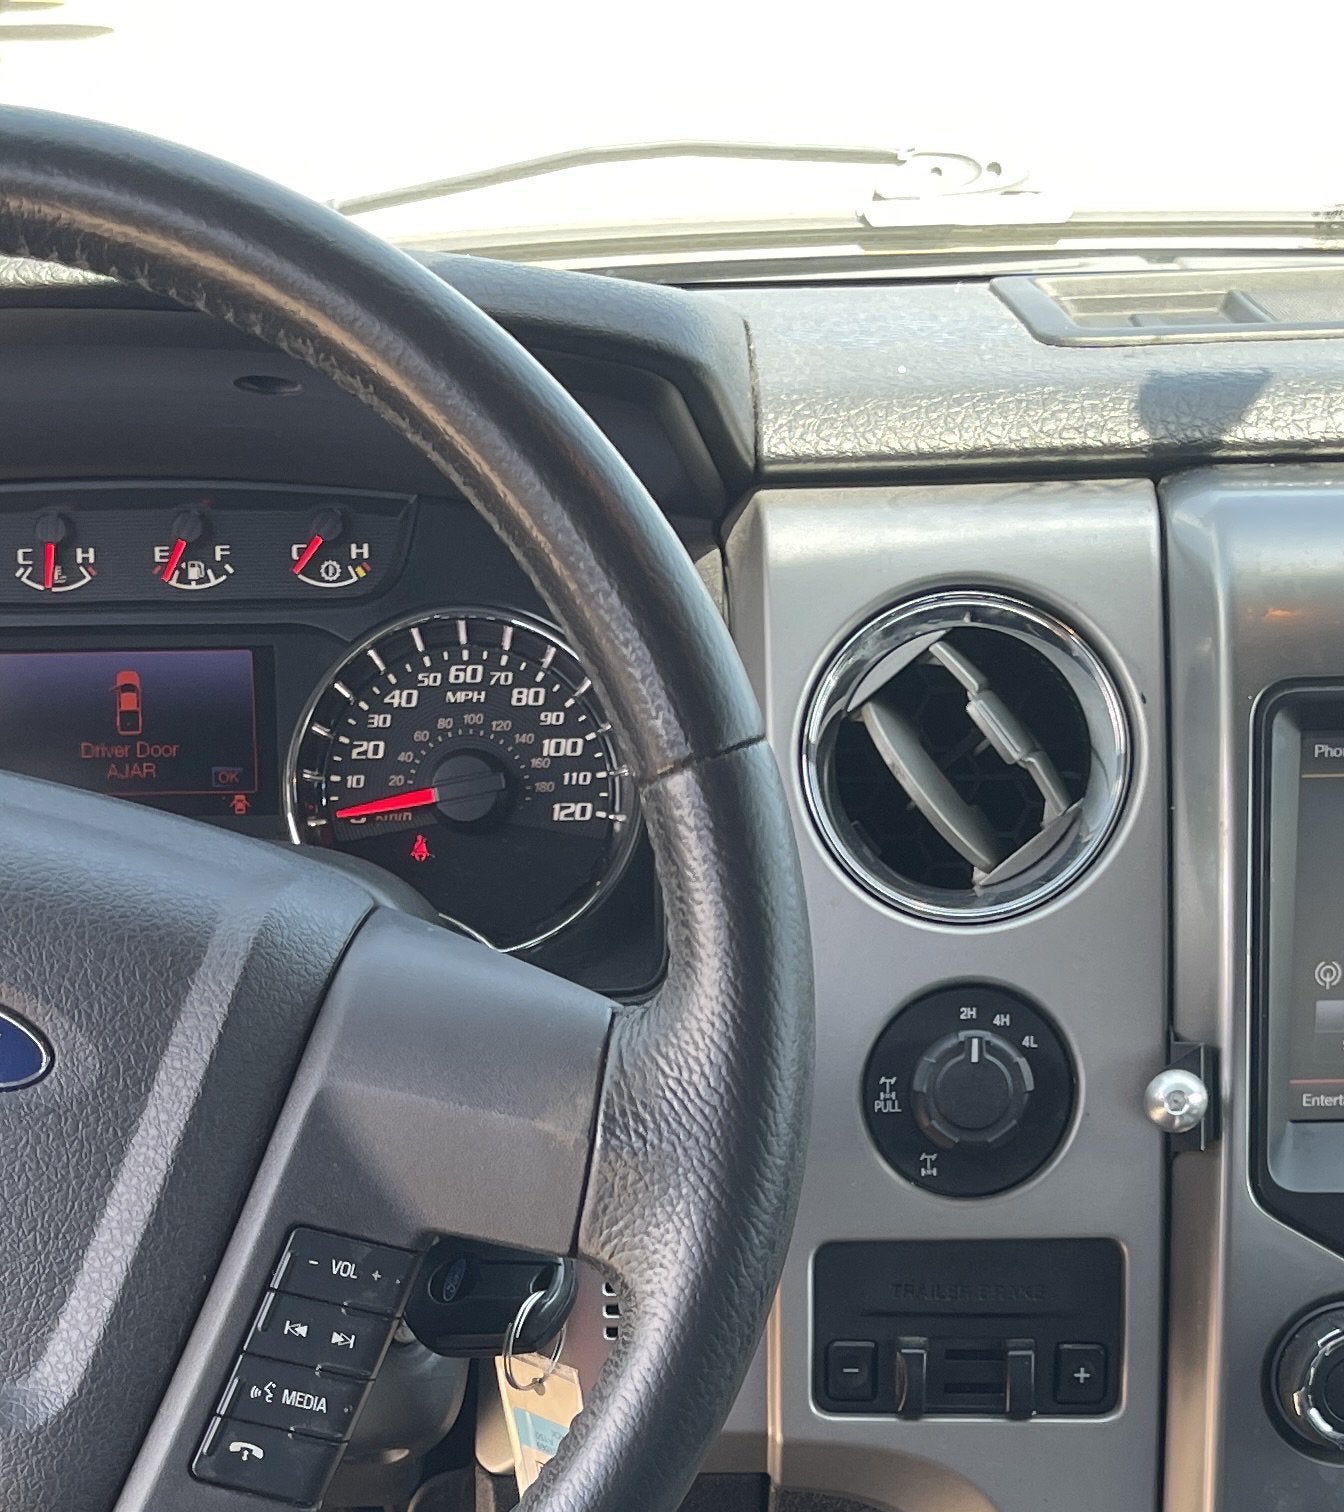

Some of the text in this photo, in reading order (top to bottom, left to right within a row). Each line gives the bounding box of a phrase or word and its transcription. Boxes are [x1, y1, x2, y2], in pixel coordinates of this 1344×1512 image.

[16, 548, 34, 565] C
[75, 547, 96, 565] H
[154, 546, 170, 563] E
[215, 545, 231, 562] F
[350, 543, 370, 560] H
[416, 672, 442, 687] 50
[448, 664, 484, 684] 60
[488, 671, 514, 686] 70
[383, 689, 419, 708] 40
[444, 690, 486, 704] MPH
[510, 687, 546, 707] 80
[366, 713, 392, 729] 30
[436, 718, 454, 730] 80
[462, 713, 484, 725] 100
[491, 719, 512, 732] 120
[539, 711, 565, 726] 90
[413, 731, 430, 742] 60
[514, 733, 535, 745] 140
[80, 740, 179, 759] Driver Door
[350, 740, 386, 760] 20
[541, 737, 584, 757] 100
[397, 752, 414, 763] 40
[530, 758, 551, 769] 160
[107, 763, 157, 779] AJAR
[218, 771, 240, 783] OK
[562, 771, 592, 786] 110
[346, 774, 365, 789] 10
[388, 775, 405, 787] 20
[534, 782, 555, 793] 180
[552, 802, 593, 822] 120
[959, 1006, 978, 1020] 2H
[992, 1013, 1011, 1027] 4H
[1022, 1035, 1039, 1049] 4L
[874, 1100, 903, 1113] PULL
[331, 1258, 358, 1280] VOL
[281, 1388, 328, 1414] MEDIA
